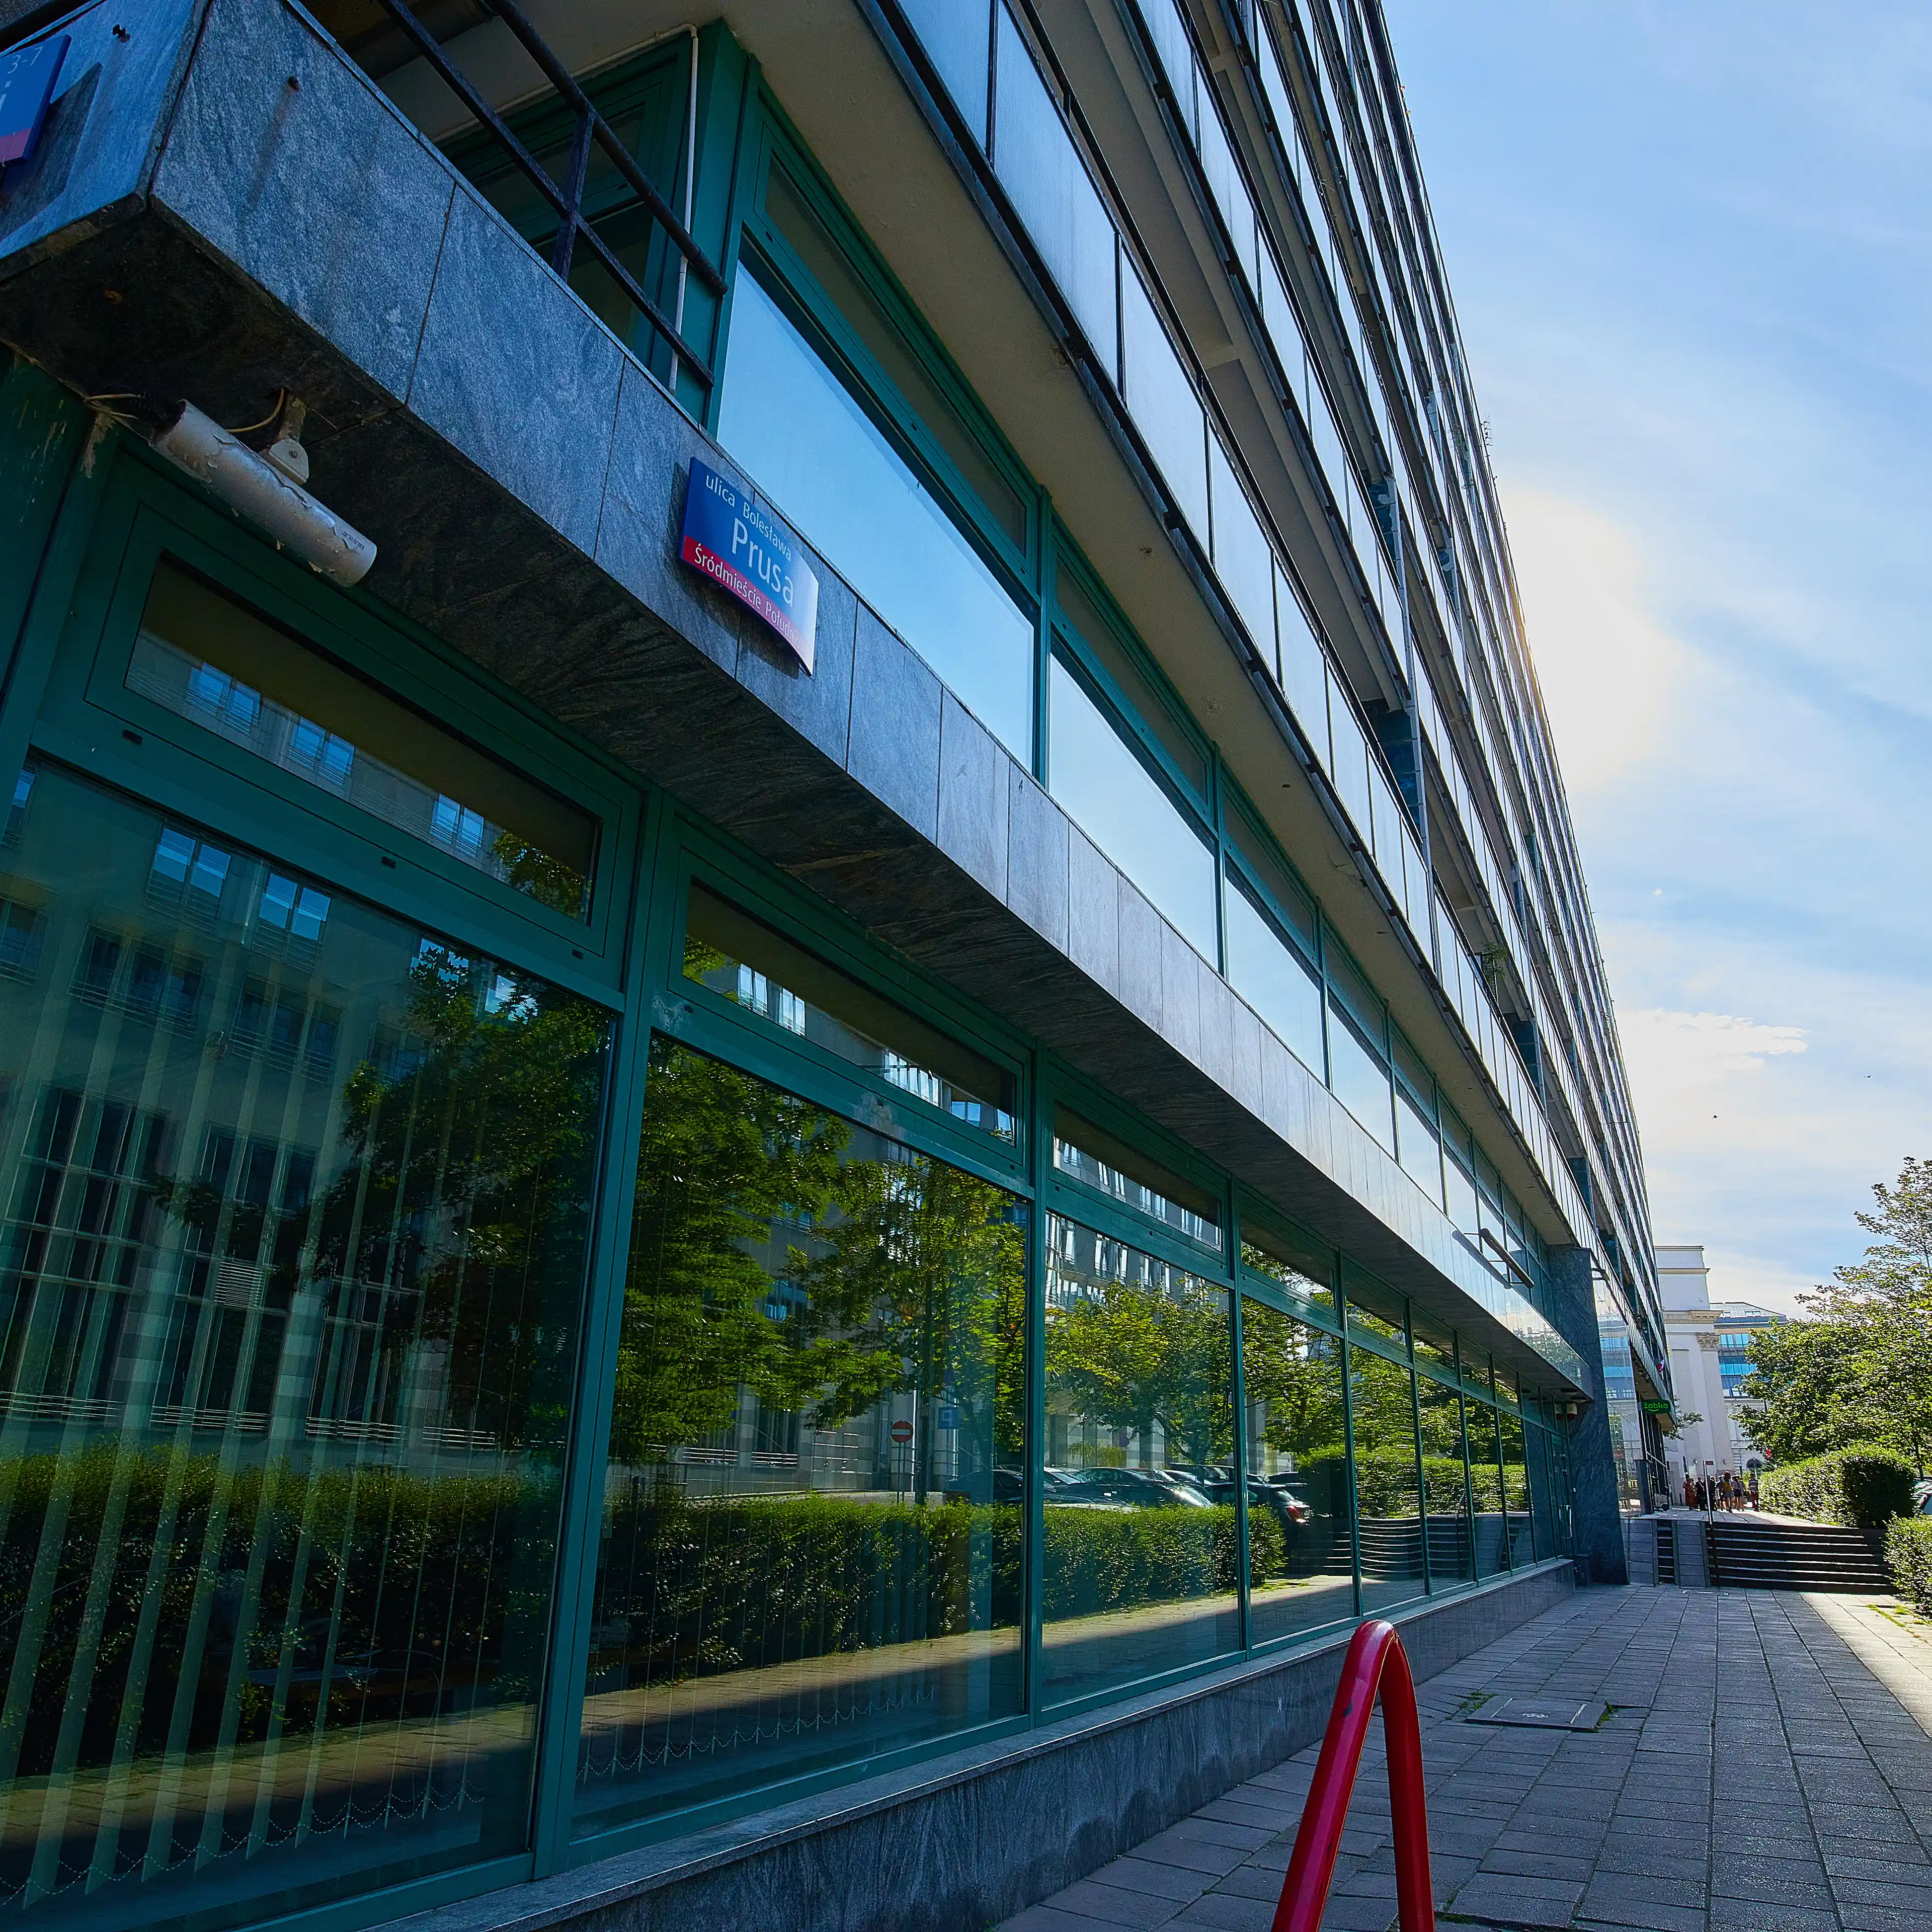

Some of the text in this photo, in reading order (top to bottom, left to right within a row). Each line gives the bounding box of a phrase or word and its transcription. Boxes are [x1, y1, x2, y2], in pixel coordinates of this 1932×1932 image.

[8, 46, 44, 74] 3-7
[706, 475, 791, 561] ulica Bolesława
[694, 543, 761, 610] Śródmieście
[732, 517, 794, 608] Prusa
